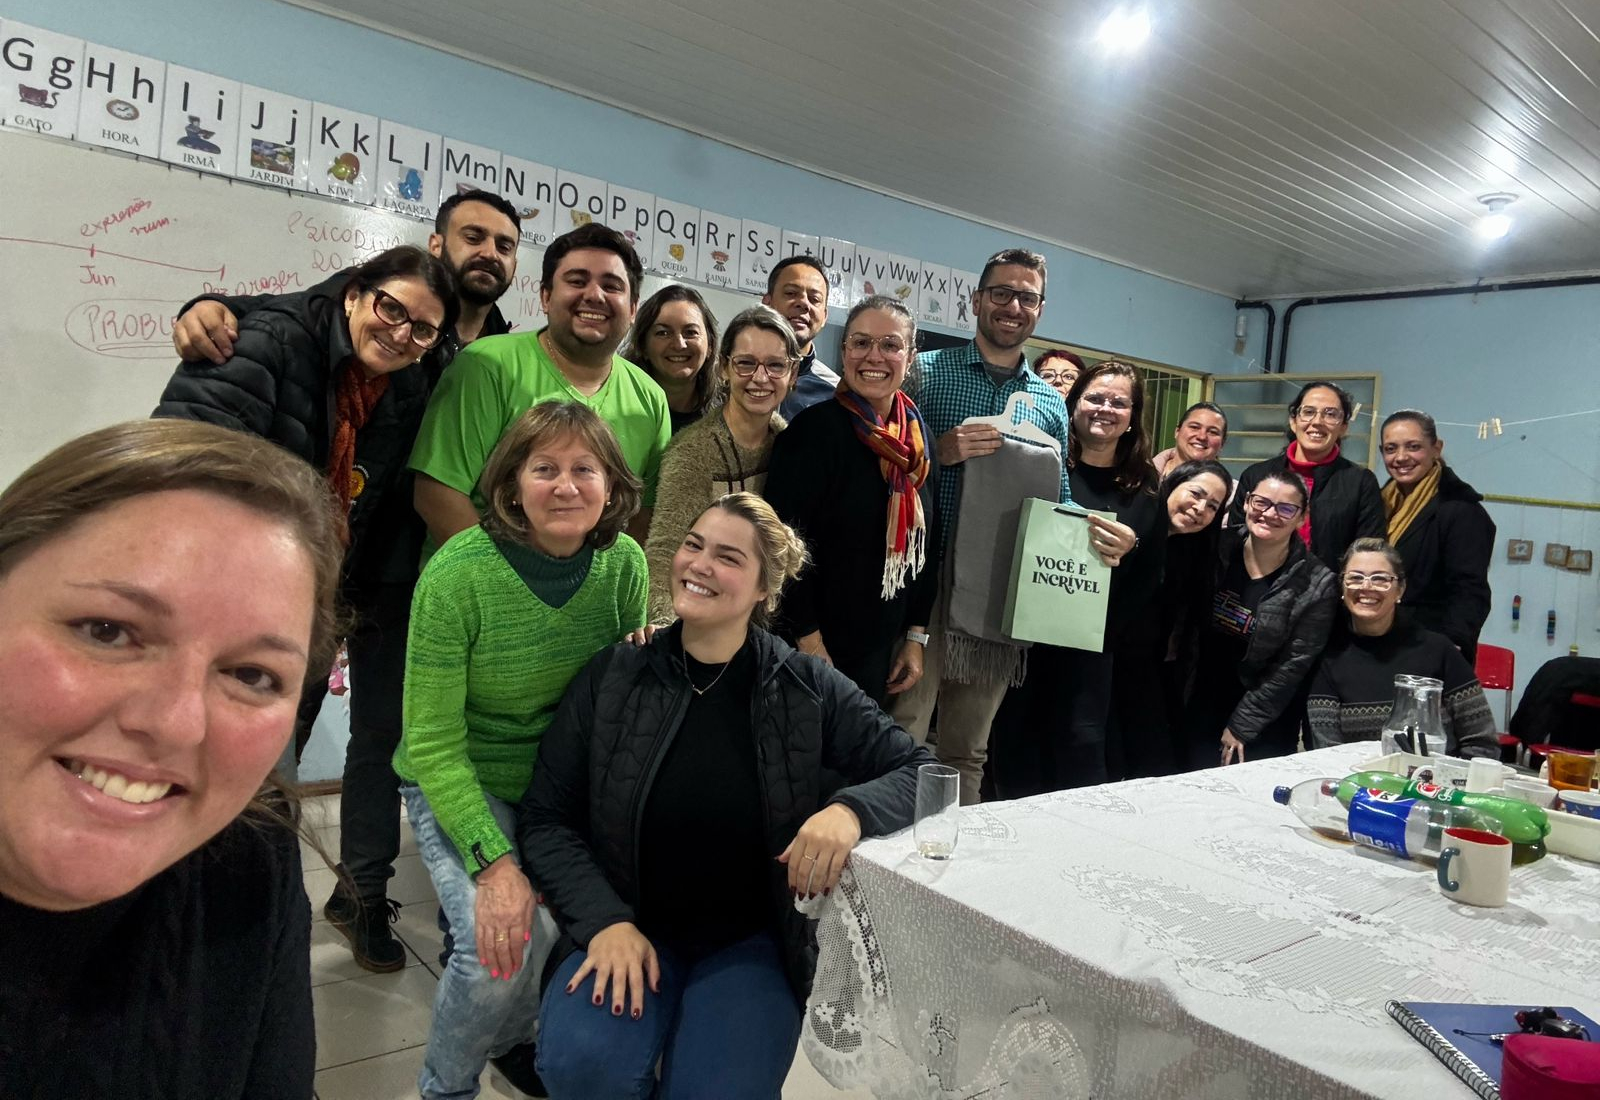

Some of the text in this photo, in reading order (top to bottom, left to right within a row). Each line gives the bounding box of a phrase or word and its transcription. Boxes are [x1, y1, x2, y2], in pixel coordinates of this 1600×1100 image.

[14, 114, 53, 132] GATO
[102, 128, 140, 147] HORA
[183, 152, 216, 170] IRMÃ
[250, 169, 295, 187] JARDIM
[328, 184, 354, 198] KIWI
[384, 198, 432, 216] LAGARTA
[520, 231, 546, 243] MERO
[80, 265, 115, 286] Jun
[661, 261, 688, 273] QUEIJO
[1035, 555, 1075, 573] VOCÊ
[1032, 570, 1100, 594] INCRÍVEL
